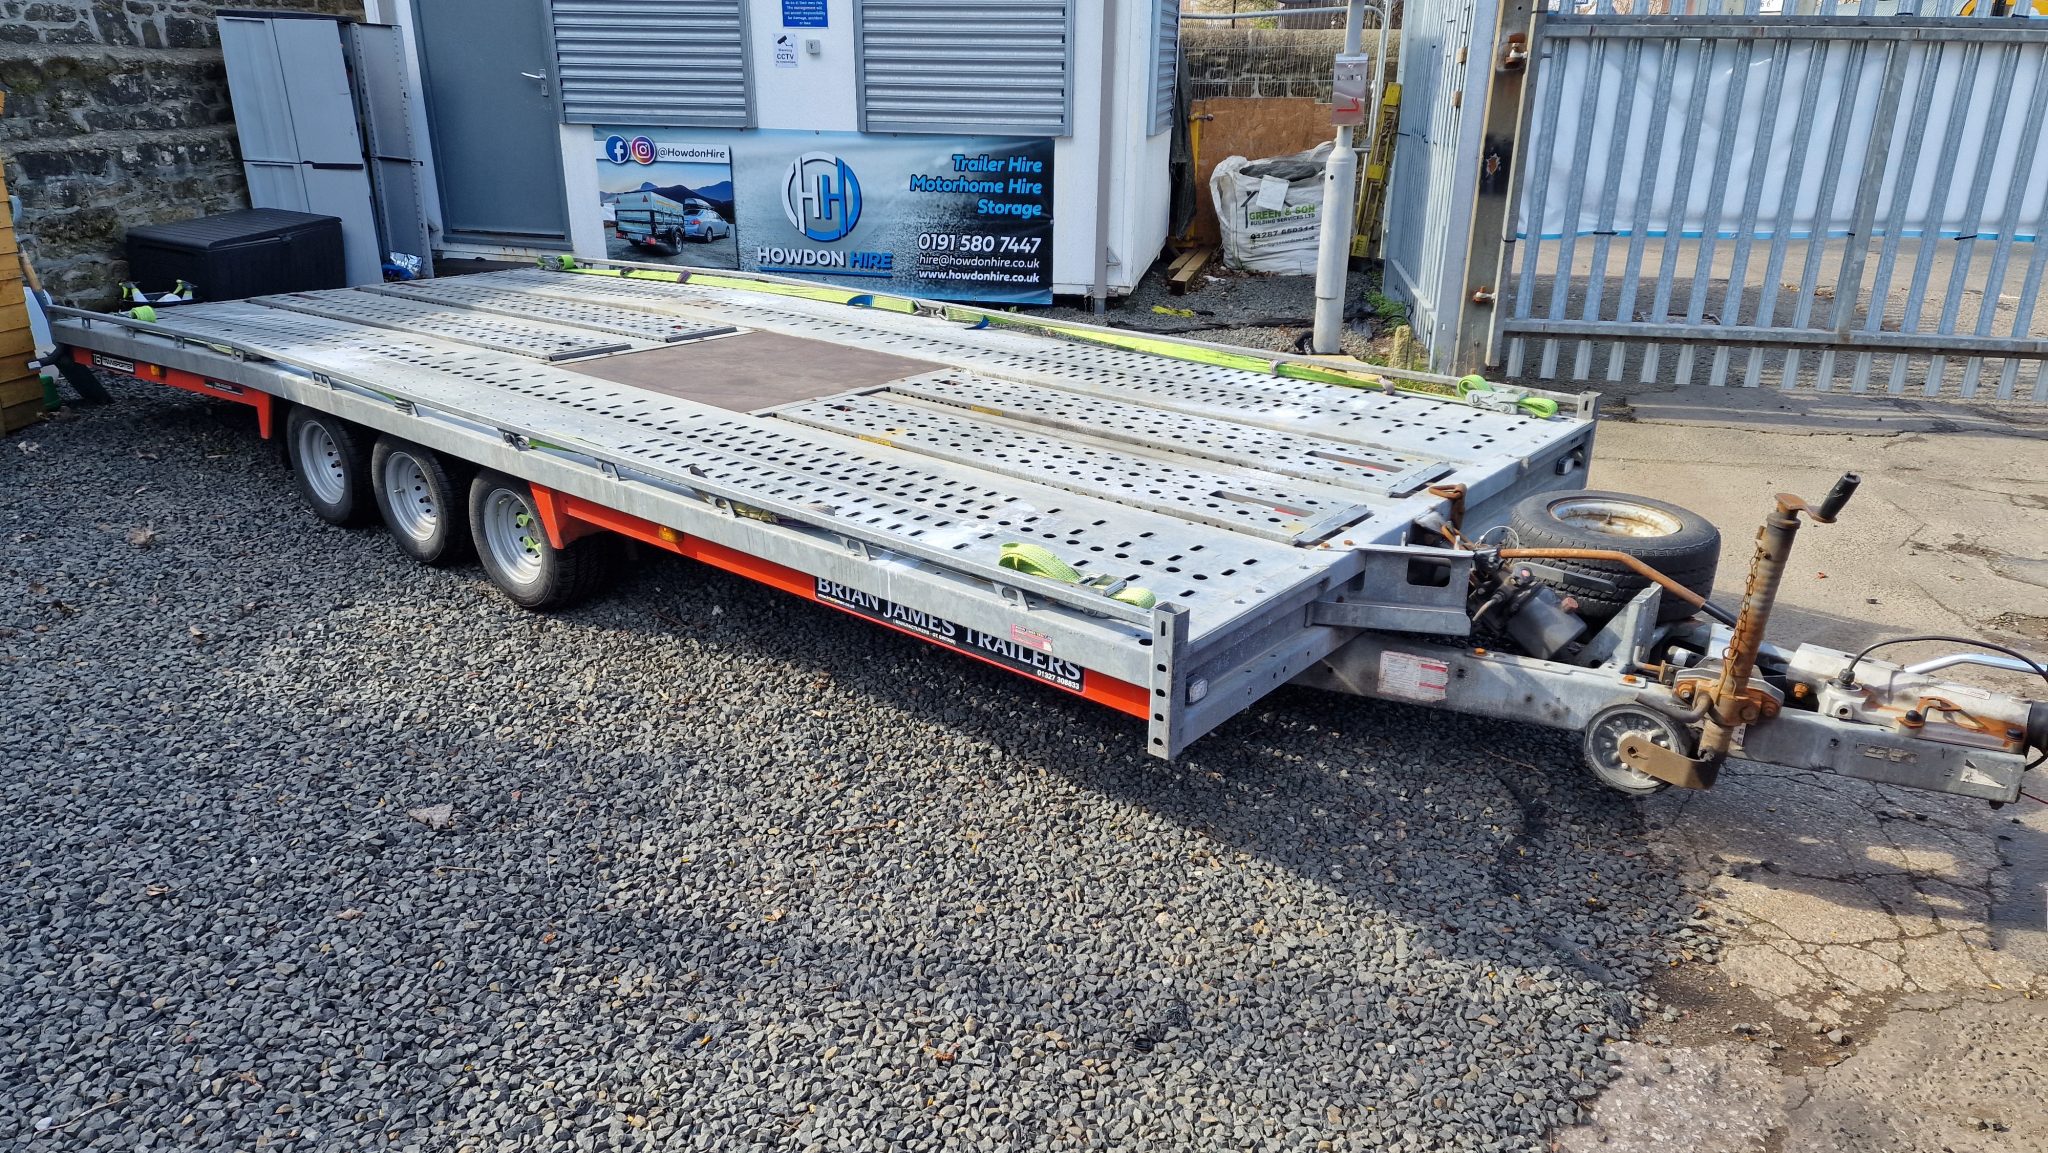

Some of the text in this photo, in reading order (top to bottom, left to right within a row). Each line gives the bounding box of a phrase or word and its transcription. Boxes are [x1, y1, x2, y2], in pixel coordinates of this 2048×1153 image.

[658, 147, 725, 159] @HowdonHire
[952, 154, 1043, 173] Trailer Hire
[910, 175, 1043, 194] Motorhome Hire
[977, 199, 1042, 219] Storage
[1249, 204, 1315, 220] GREEN & SON
[1250, 218, 1276, 226] BUILDING
[1277, 215, 1304, 223] SERVICES
[918, 233, 1042, 254] 0191 580 7447
[757, 247, 893, 269] HOWDON HIRE
[919, 254, 1040, 269] hire@howdonhire.co.uk
[918, 270, 1040, 283] www.howdonhire.co.uk
[818, 578, 879, 611] BRIAN
[883, 601, 956, 637] JAMES
[965, 628, 1081, 680] TRAILERS
